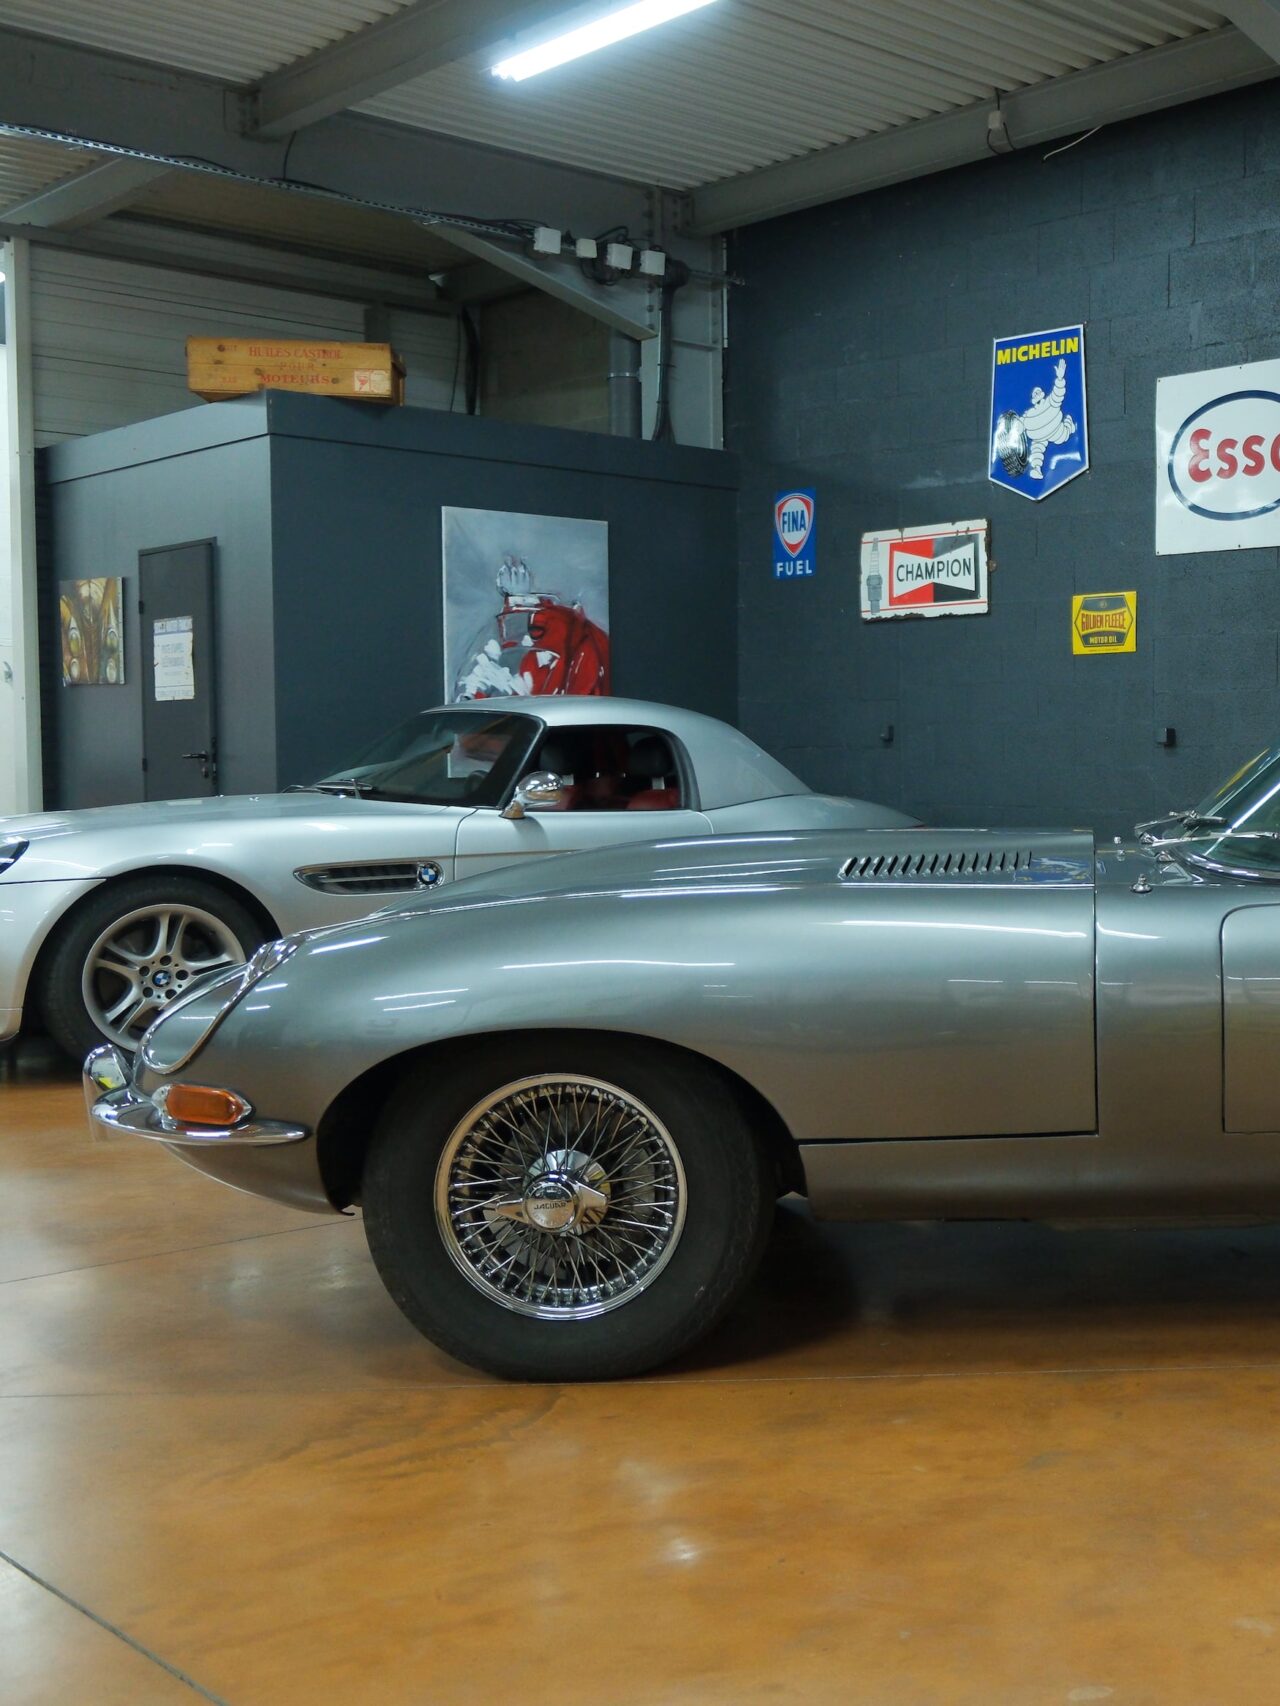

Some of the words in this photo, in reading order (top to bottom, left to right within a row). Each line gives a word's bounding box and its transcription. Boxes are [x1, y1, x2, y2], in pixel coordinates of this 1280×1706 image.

[996, 337, 1079, 365] MICHELIN
[782, 509, 807, 534] FINA
[776, 559, 813, 577] FUEL
[896, 557, 972, 583] CHAMPION
[1081, 612, 1104, 632] GOLDEN
[1104, 610, 1126, 630] FLEECE
[1089, 636, 1108, 644] MOTOR
[1108, 635, 1117, 643] OIL
